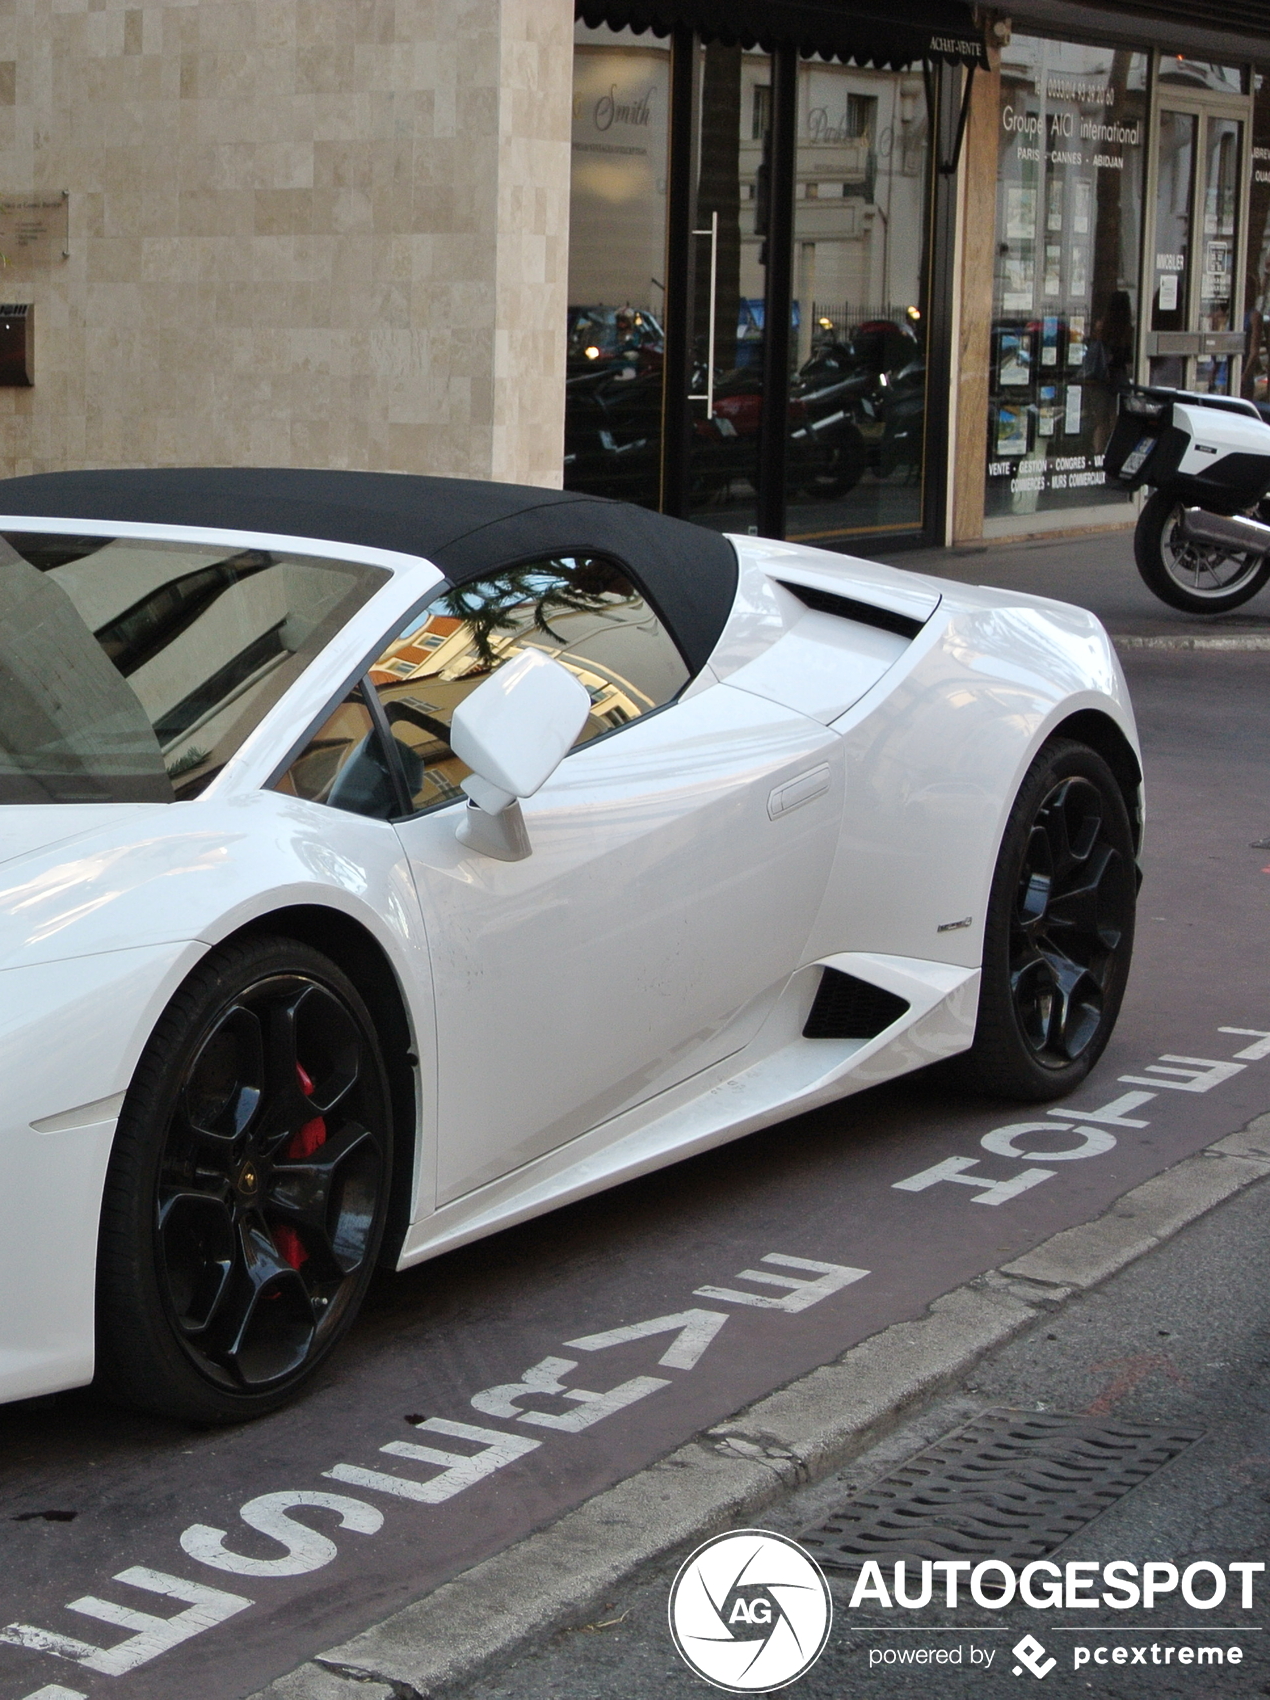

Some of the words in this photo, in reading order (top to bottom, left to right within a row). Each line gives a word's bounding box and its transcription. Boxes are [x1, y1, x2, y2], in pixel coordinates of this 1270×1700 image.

[929, 36, 982, 57] ACHAT-VENTE
[593, 83, 658, 132] Smith
[1002, 105, 1044, 143] Groupe
[1080, 116, 1141, 146] international
[1017, 149, 1040, 162] PARIS
[1051, 151, 1082, 166] CANNES
[1092, 154, 1124, 169] ABIDJAN
[988, 462, 1011, 476] VENTE
[1018, 459, 1048, 474] GESTION
[1010, 476, 1045, 493] COMMERCES
[1051, 474, 1068, 489] MURS
